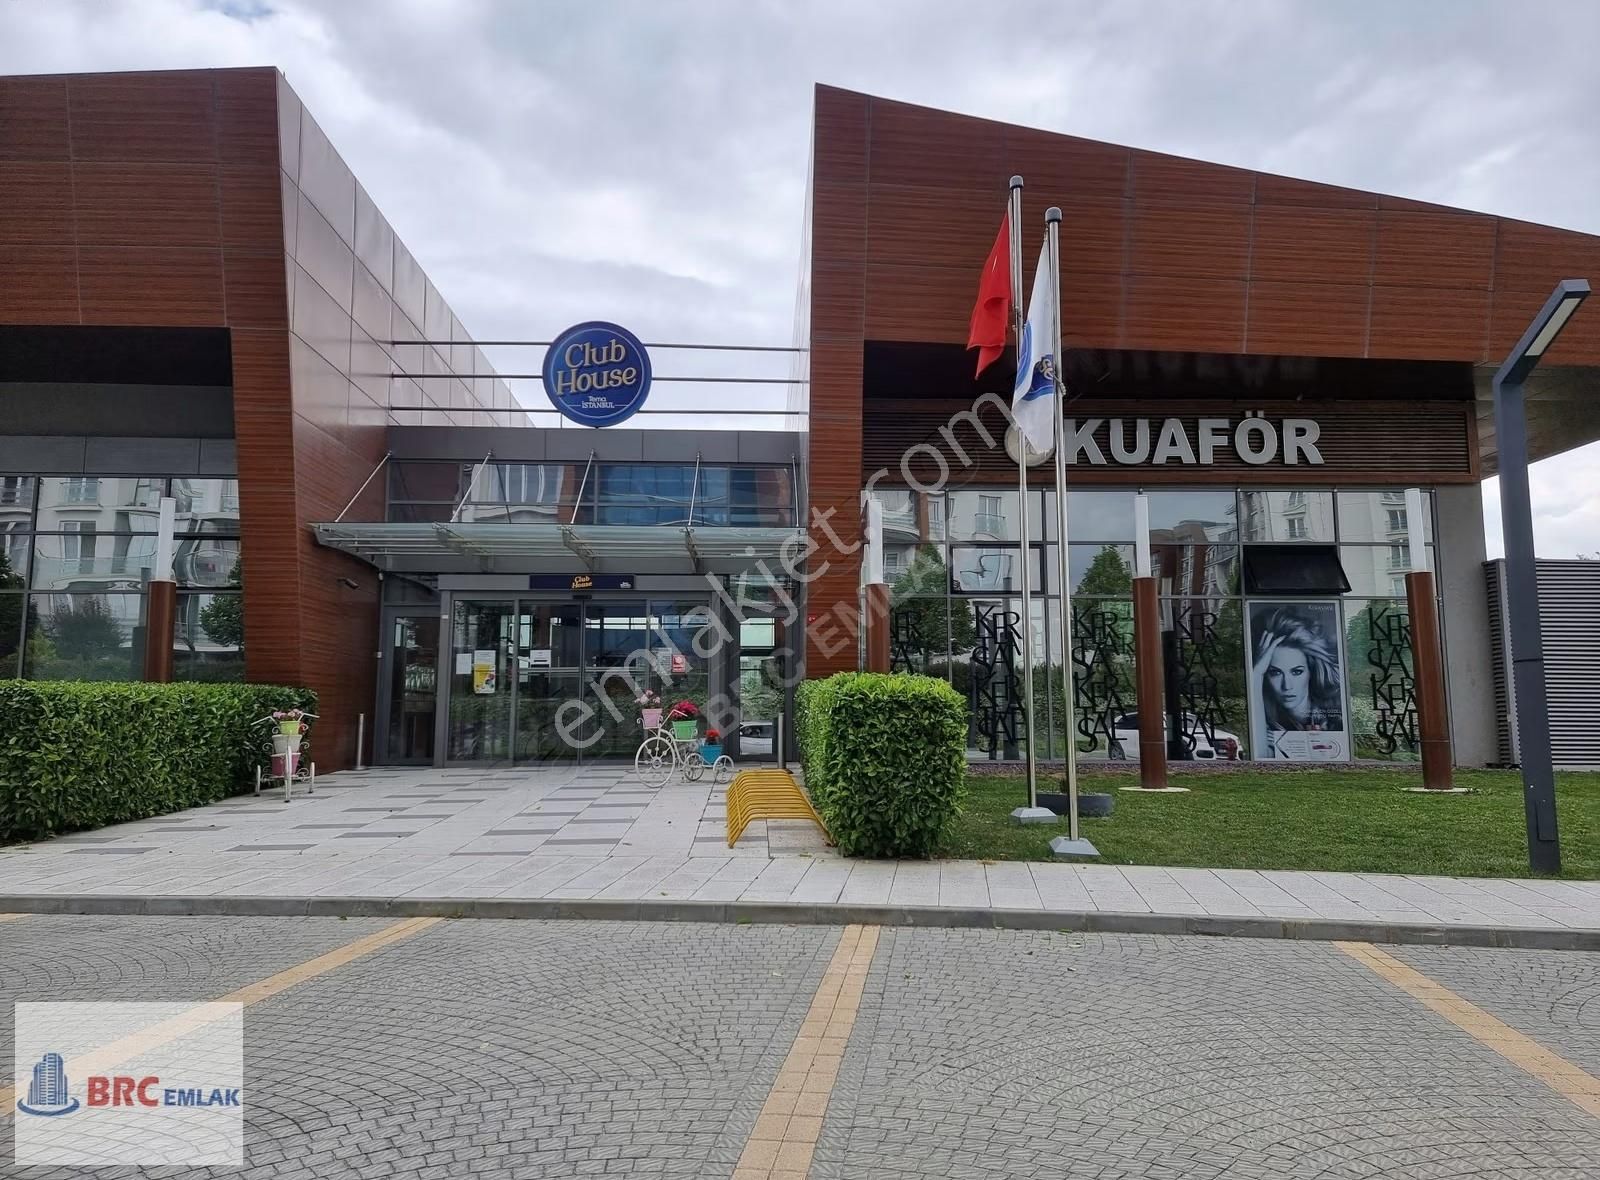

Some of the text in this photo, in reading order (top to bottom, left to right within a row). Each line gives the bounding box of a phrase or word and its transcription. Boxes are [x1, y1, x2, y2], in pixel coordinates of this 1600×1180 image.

[565, 339, 626, 368] Club
[556, 367, 637, 396] House
[1063, 410, 1325, 466] KUAFÖR
